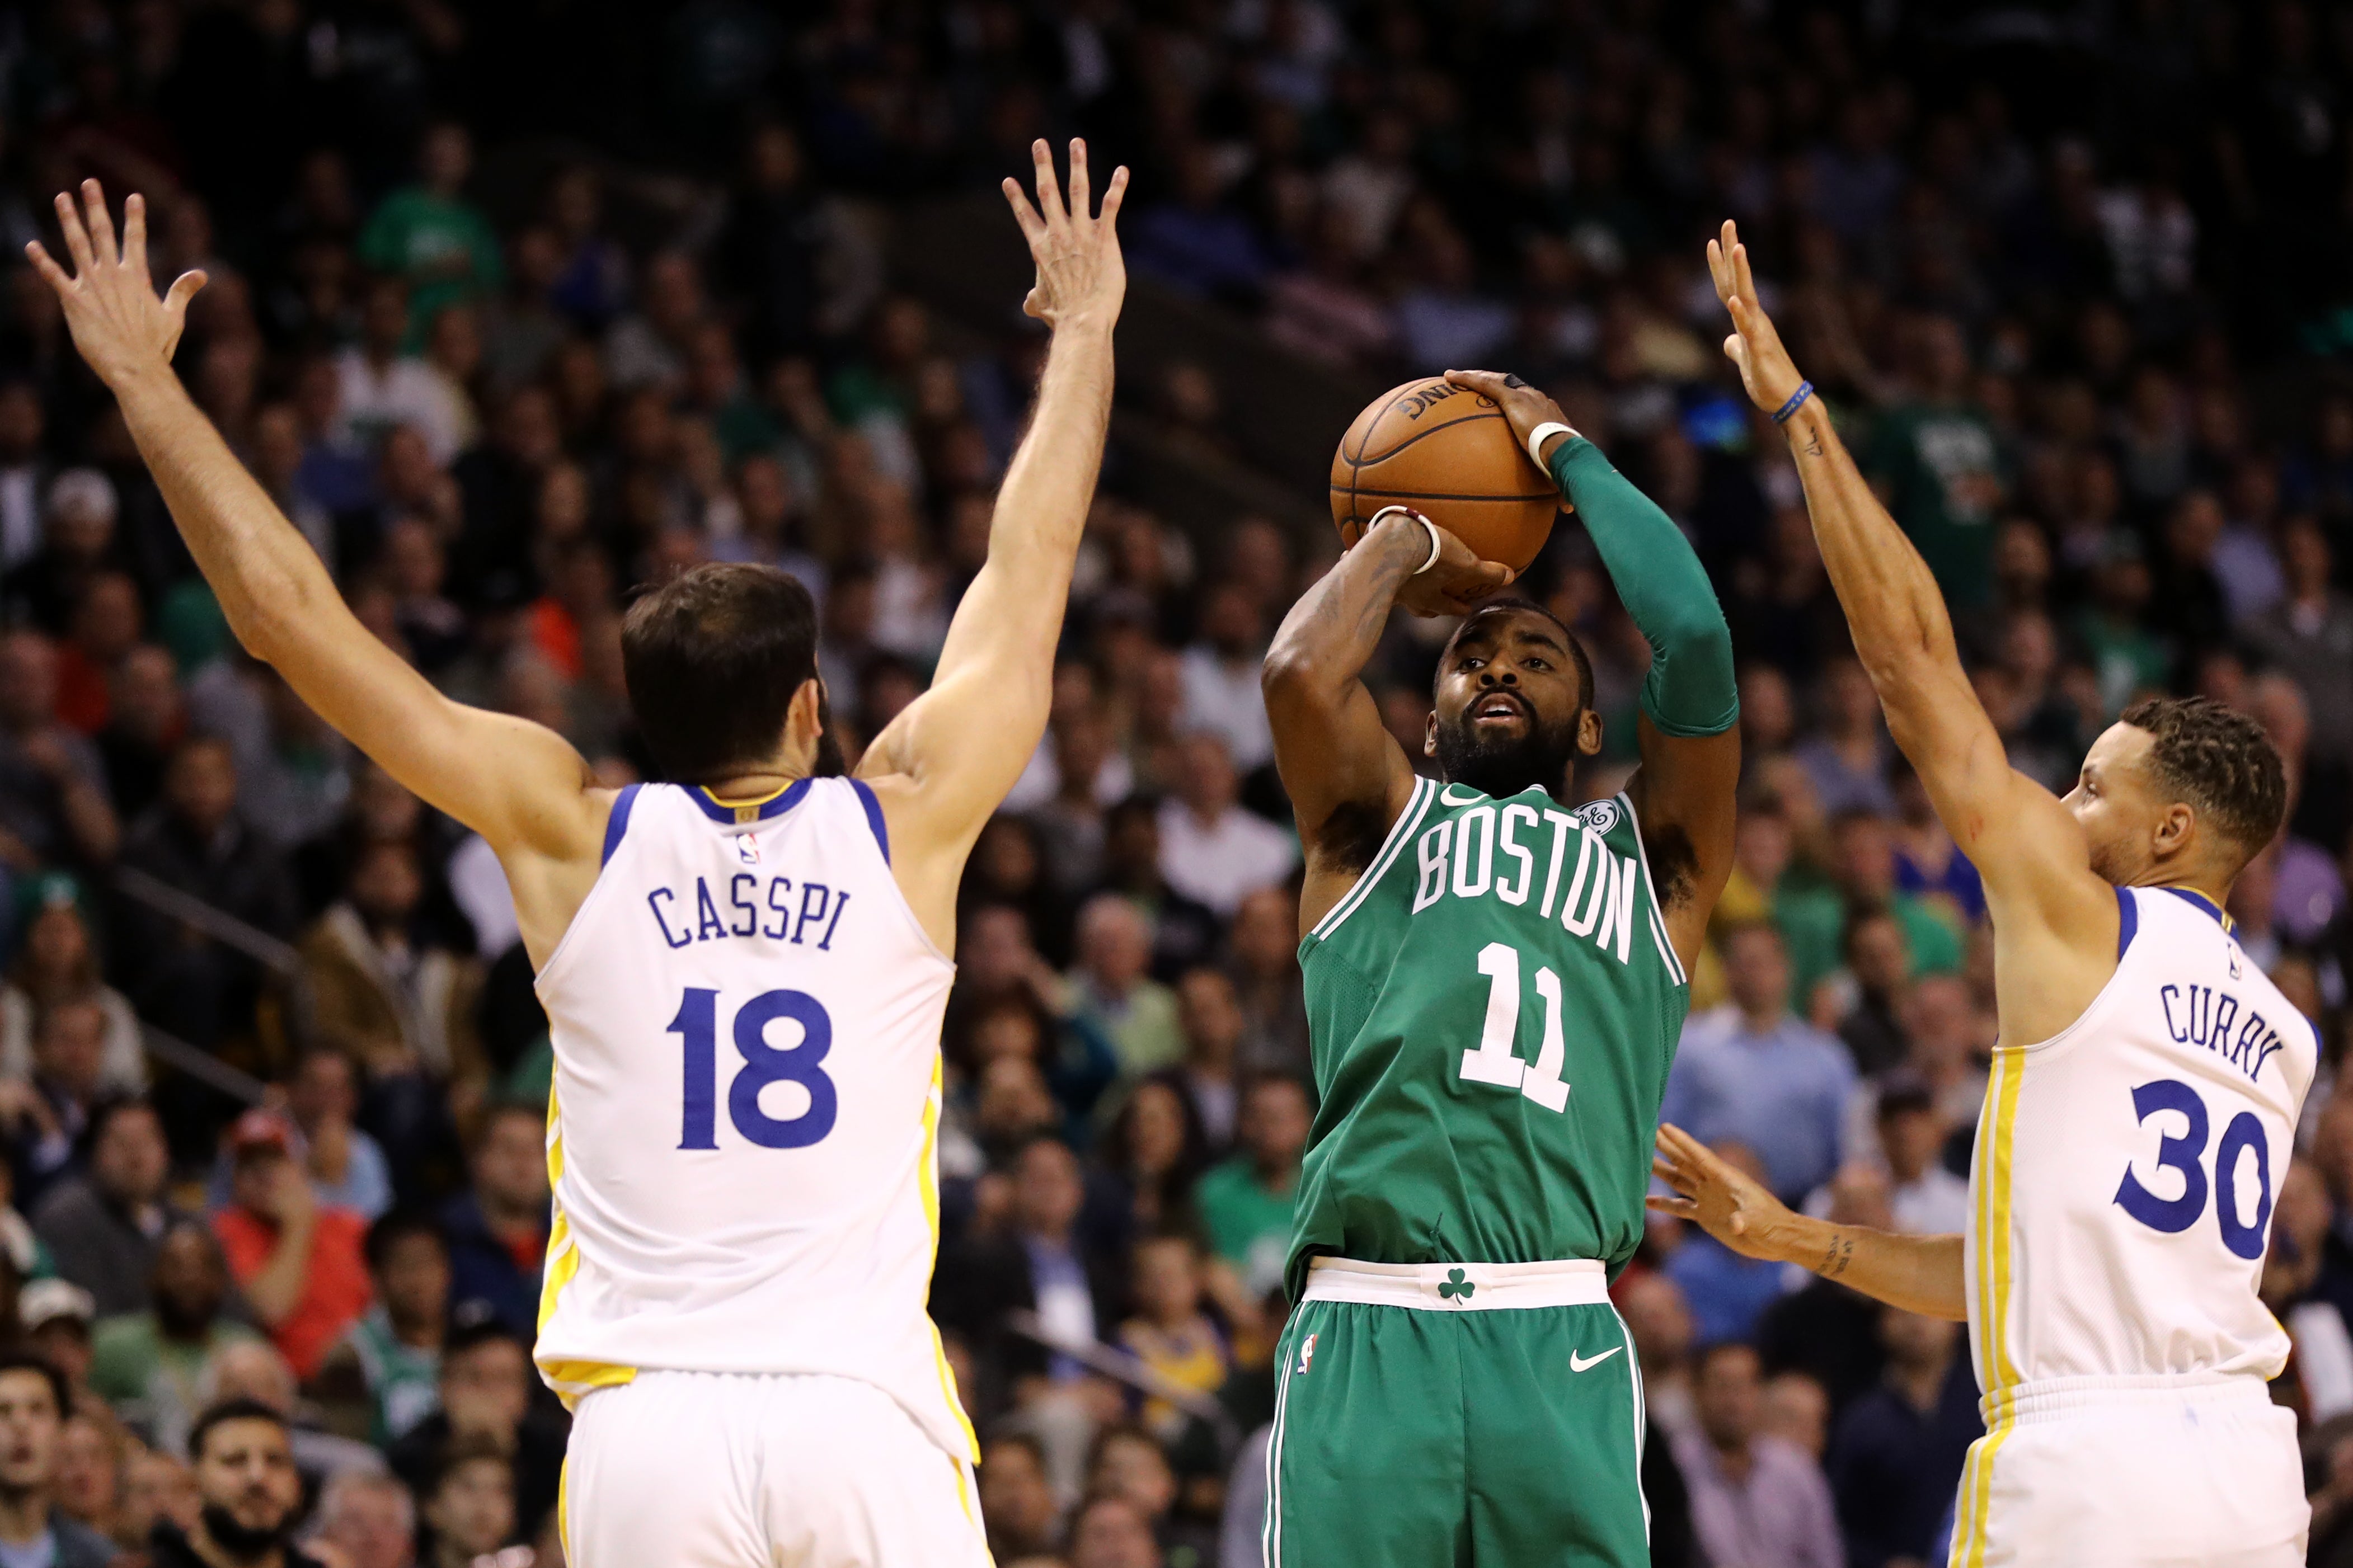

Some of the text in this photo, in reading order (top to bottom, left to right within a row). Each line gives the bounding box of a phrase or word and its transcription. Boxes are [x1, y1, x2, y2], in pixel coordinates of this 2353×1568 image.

[647, 874, 851, 951] CASSPI
[1412, 803, 1637, 966] BOSTON
[666, 987, 837, 1150] 18
[1459, 941, 1571, 1114] 11
[2161, 984, 2283, 1082] CURRY
[2112, 1080, 2272, 1260] 30
